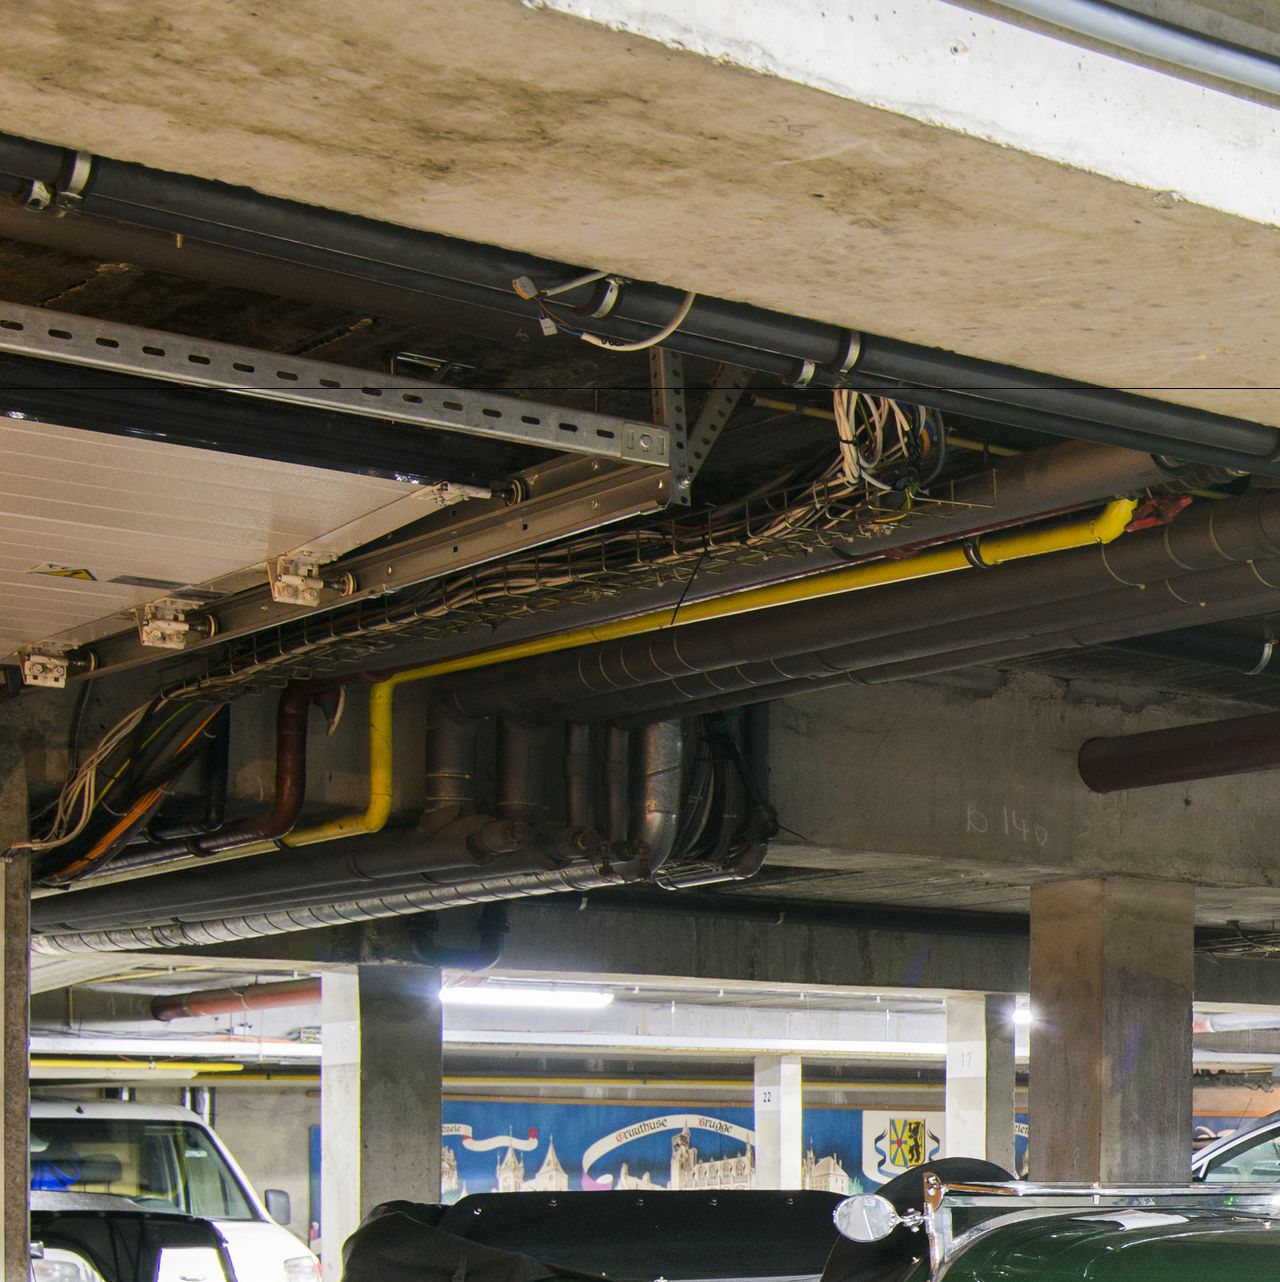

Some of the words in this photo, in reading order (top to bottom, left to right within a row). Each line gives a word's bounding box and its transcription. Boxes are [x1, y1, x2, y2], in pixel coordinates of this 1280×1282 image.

[1003, 806, 1048, 846] 140
[960, 1051, 973, 1068] 17
[763, 1091, 772, 1103] 22
[698, 1117, 733, 1134] Brugge
